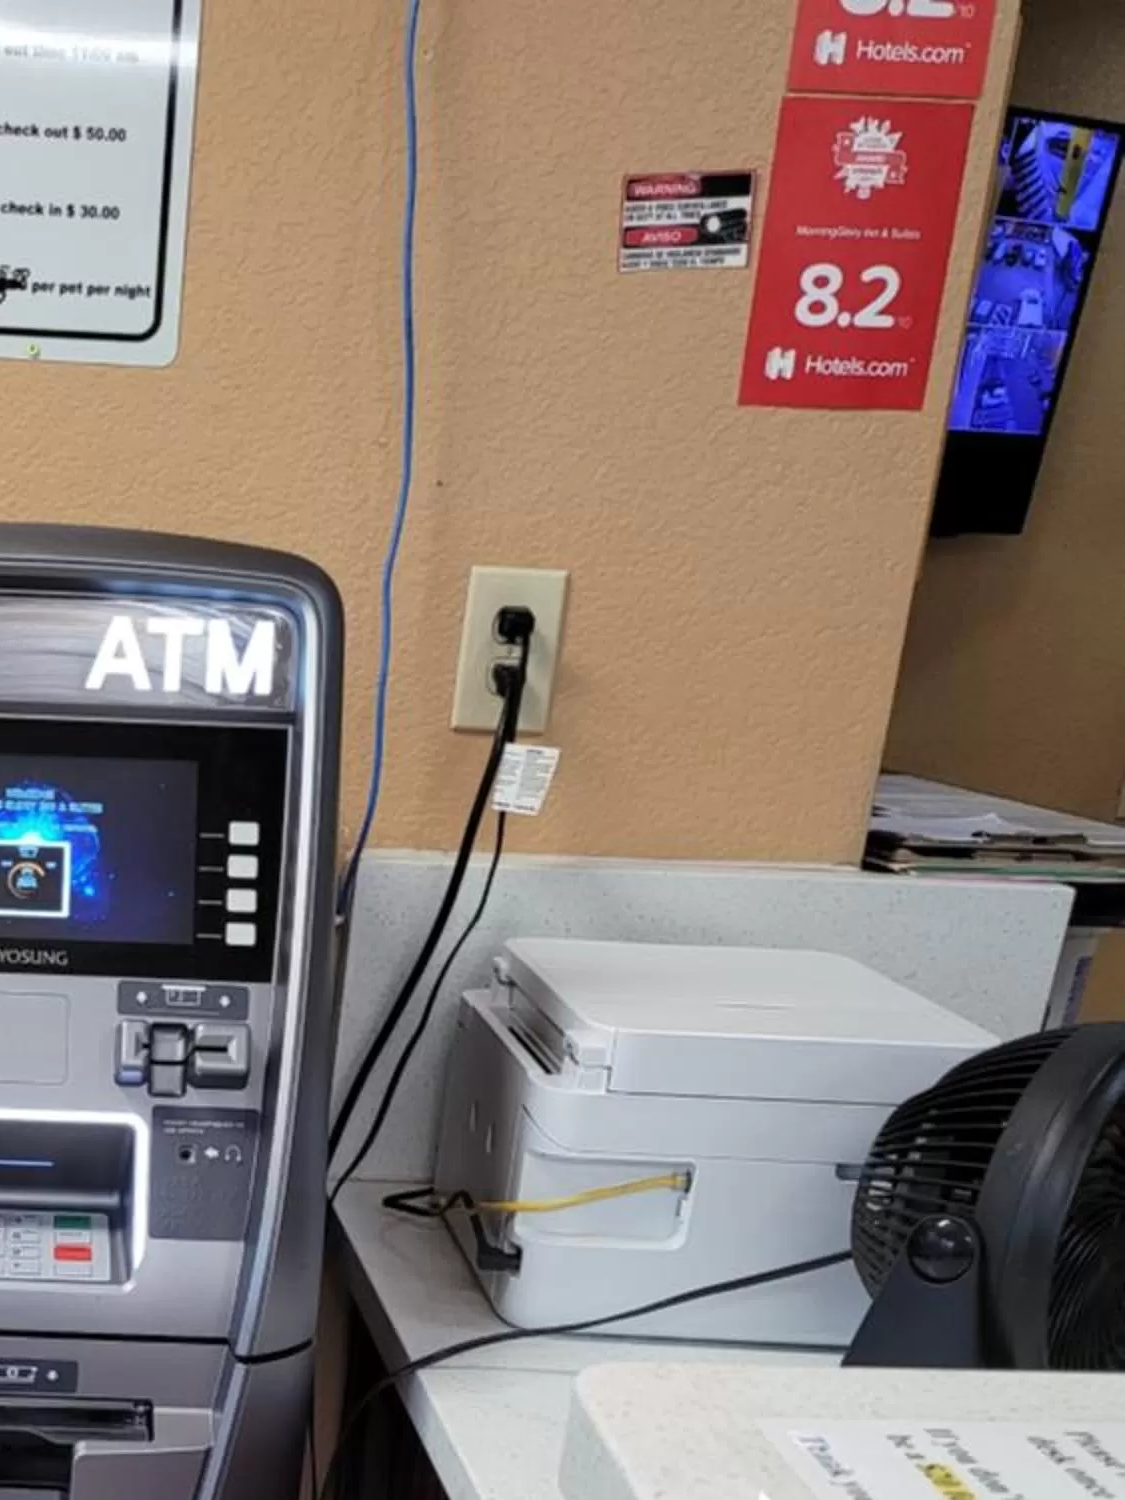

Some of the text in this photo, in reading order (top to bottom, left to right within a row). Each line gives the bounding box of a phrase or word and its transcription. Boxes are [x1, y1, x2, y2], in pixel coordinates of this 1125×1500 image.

[856, 39, 965, 64] Hotels.com
[43, 126, 68, 140] out
[72, 126, 82, 141] $
[85, 127, 127, 142] 50.00
[0, 200, 44, 216] check
[48, 203, 63, 216] in
[66, 204, 76, 219] $
[80, 205, 121, 221] 30.00
[31, 279, 56, 296] per
[57, 282, 83, 298] pet
[86, 284, 111, 300] per
[114, 284, 152, 301] night
[794, 262, 902, 328] 8.2
[804, 355, 909, 377] Hotels.com
[84, 614, 275, 695] ATM
